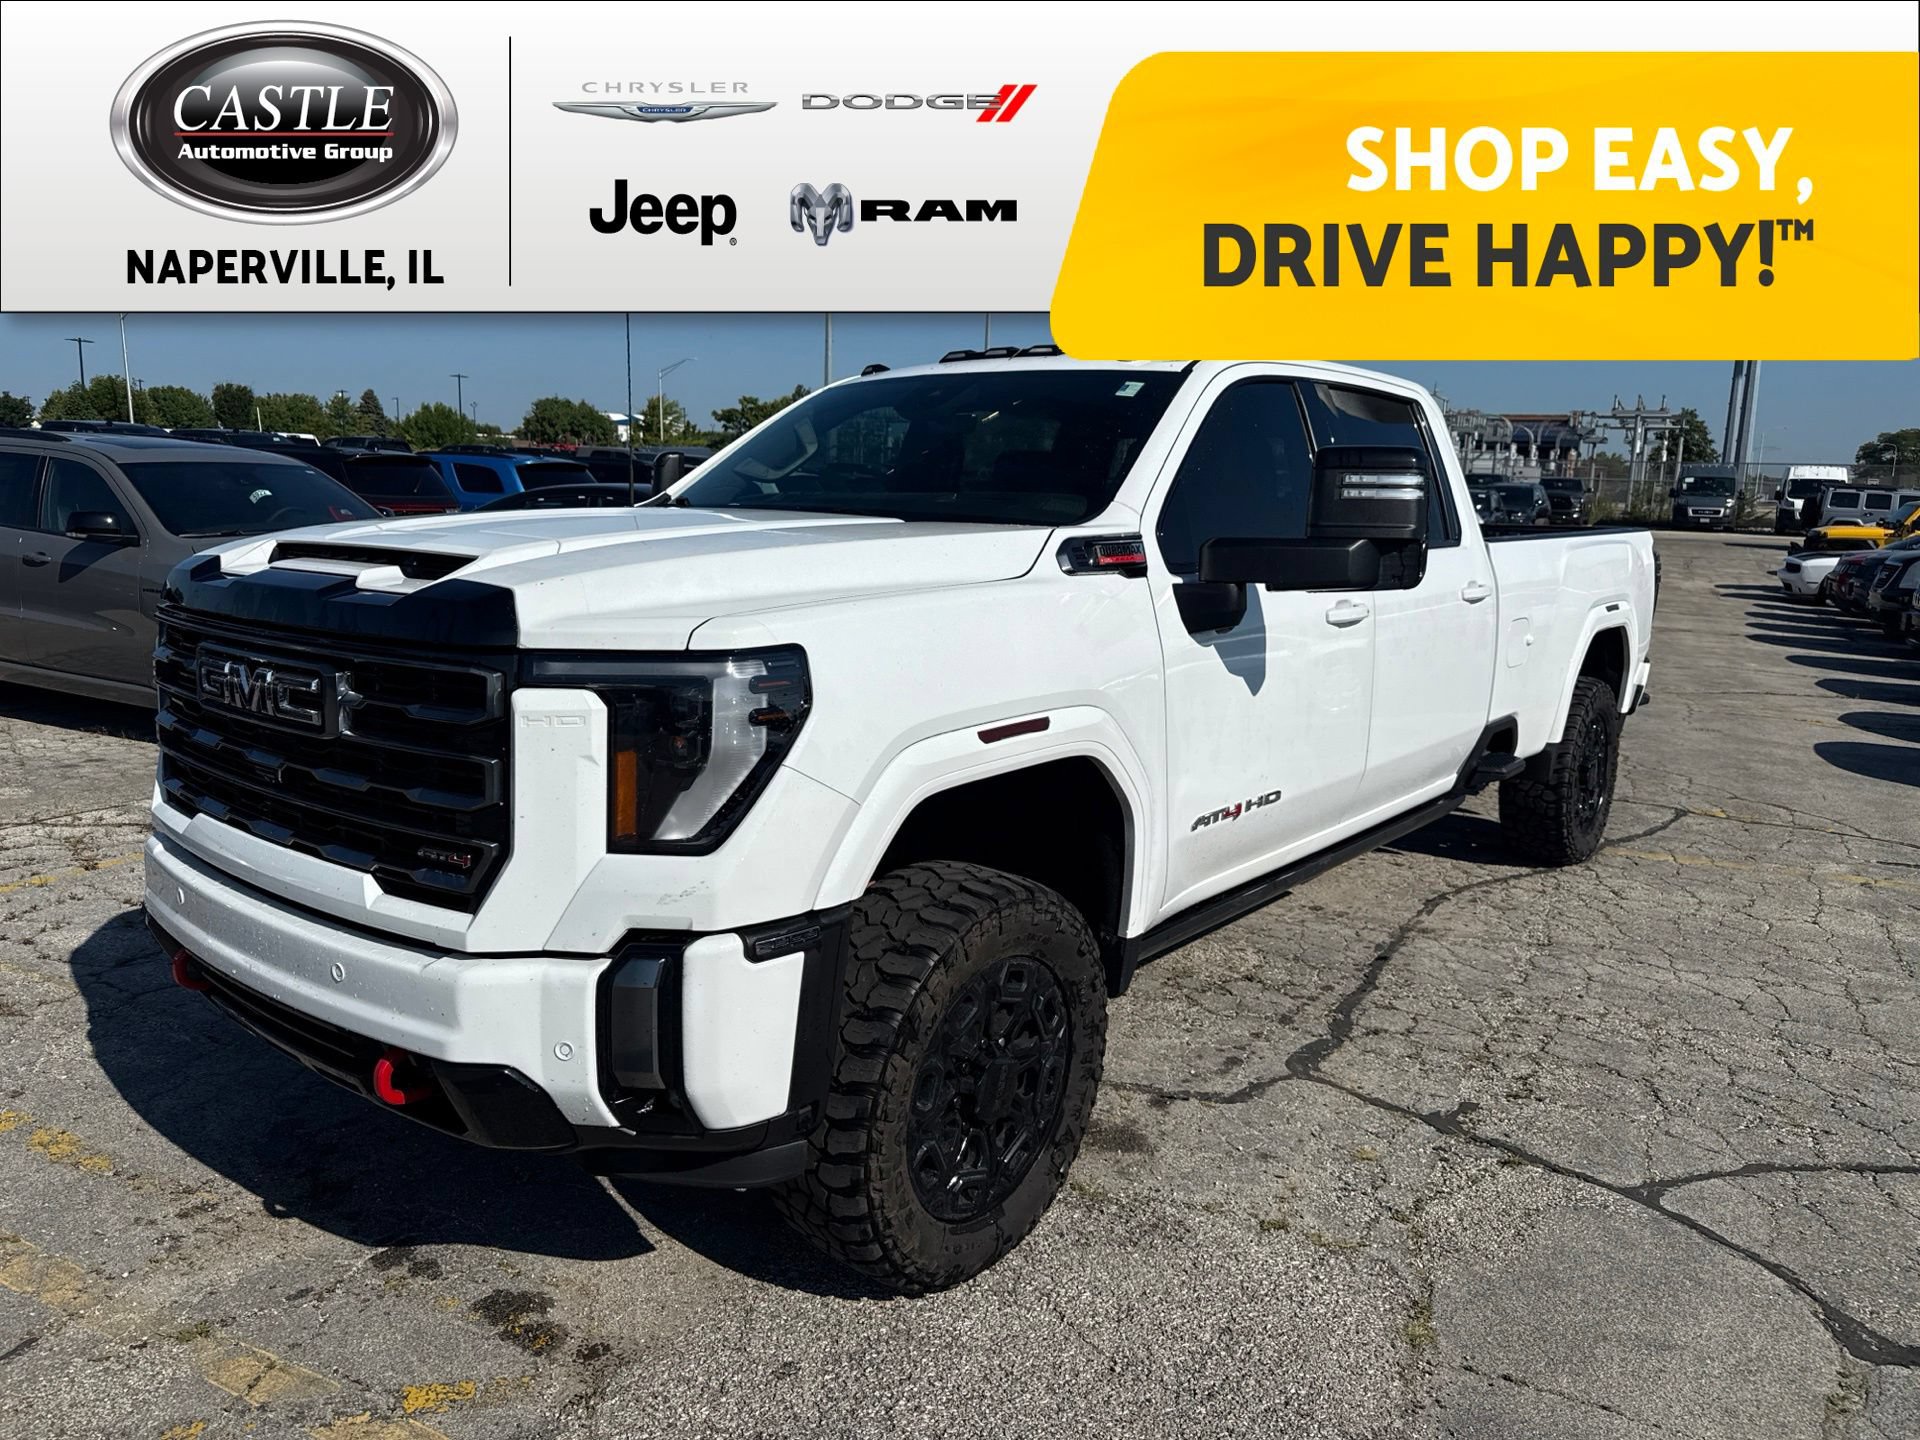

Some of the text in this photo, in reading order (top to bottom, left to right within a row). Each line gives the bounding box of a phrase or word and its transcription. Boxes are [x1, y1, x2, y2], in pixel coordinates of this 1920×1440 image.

[200, 659, 321, 726] GMC
[520, 715, 585, 728] HD
[1190, 790, 1282, 832] AT4 HD
